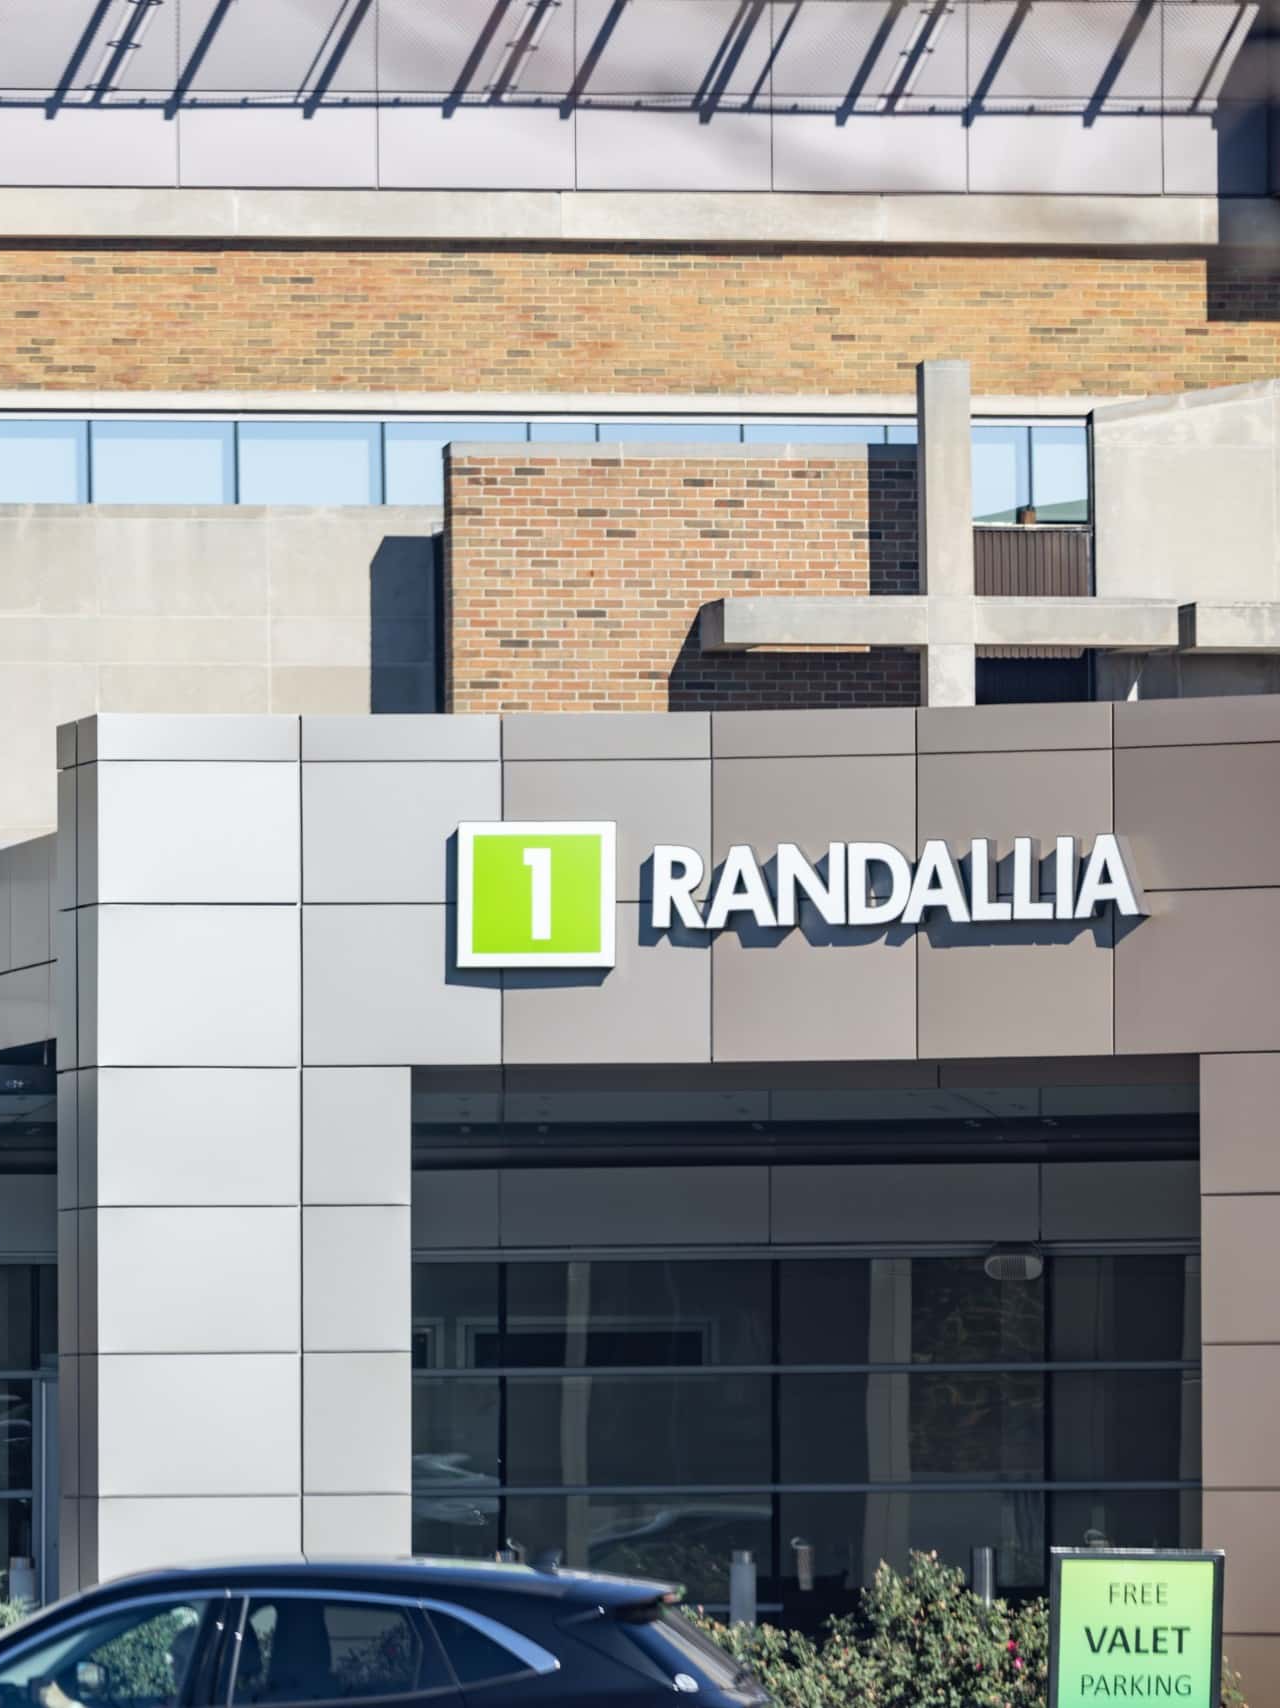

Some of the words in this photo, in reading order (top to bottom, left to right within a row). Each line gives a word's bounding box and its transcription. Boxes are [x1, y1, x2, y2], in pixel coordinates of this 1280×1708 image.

[522, 847, 552, 941] 1
[652, 834, 1140, 929] RANDALLIA
[1108, 1582, 1169, 1606] FREE
[1084, 1626, 1191, 1655] VALET
[1081, 1674, 1193, 1698] PARKING
